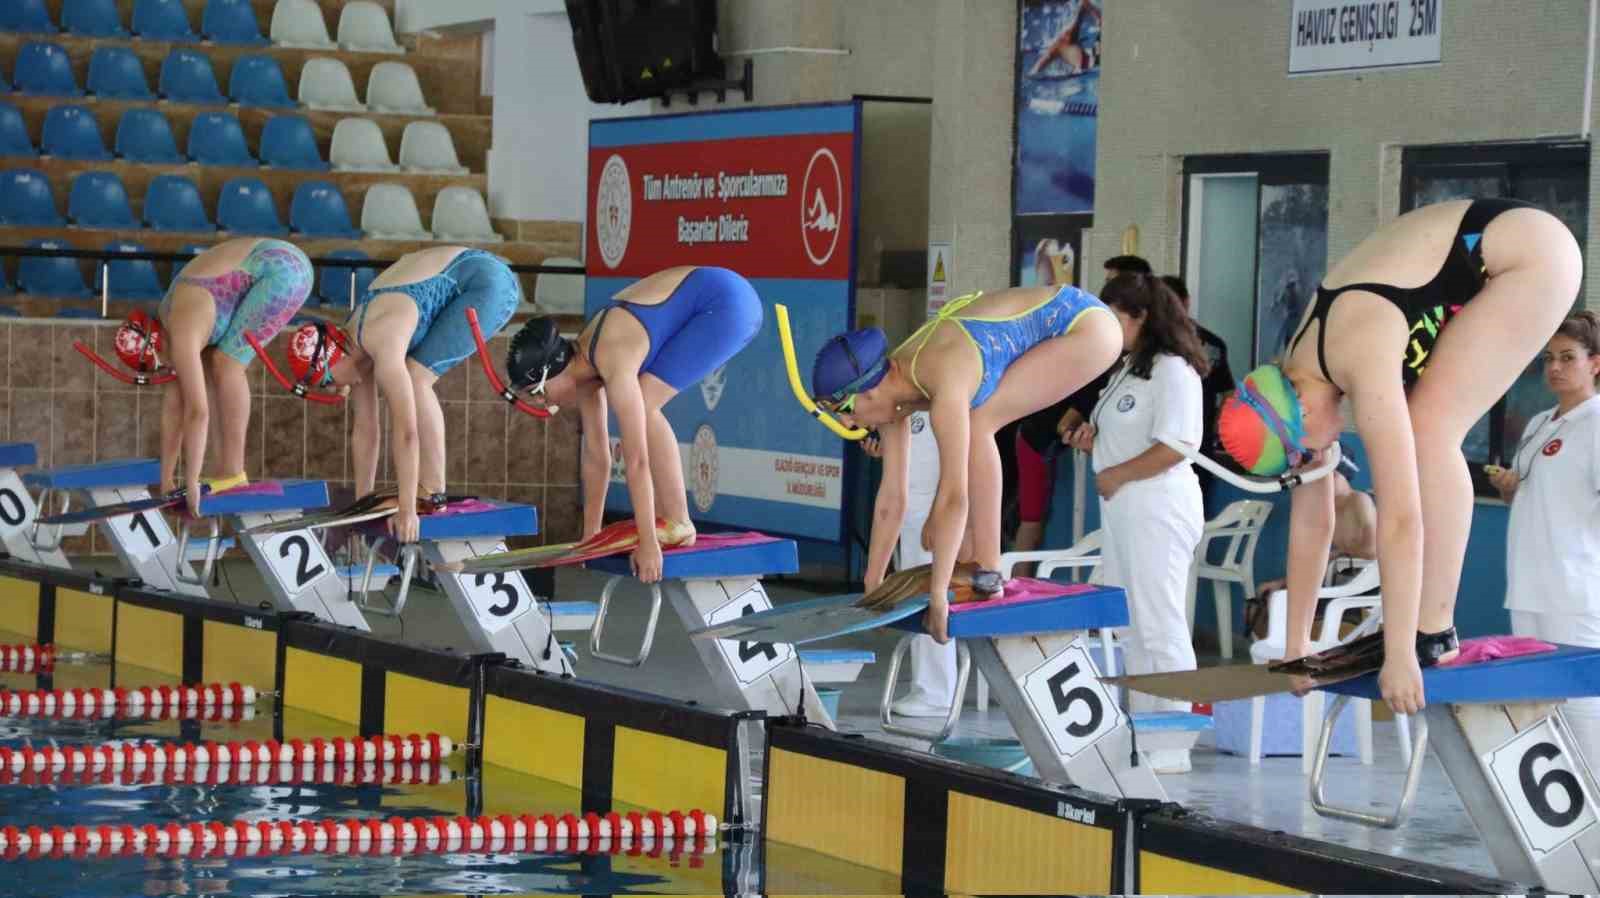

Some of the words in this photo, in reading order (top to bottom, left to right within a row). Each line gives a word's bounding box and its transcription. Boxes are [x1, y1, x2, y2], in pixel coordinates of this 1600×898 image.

[1297, 8, 1337, 46] HAVUZ
[1409, 0, 1437, 36] 25M
[643, 174, 662, 200] Tüm
[663, 172, 702, 200] Antrenör
[704, 177, 715, 198] ve
[718, 169, 788, 202] Sporcularımıza
[678, 216, 718, 246] Başarılar
[719, 214, 749, 242] Dileriz
[0, 488, 26, 526] 0
[129, 512, 161, 548] 1
[280, 535, 325, 588] 2
[475, 572, 519, 617] 3
[738, 603, 778, 664] 4
[1046, 661, 1104, 738] 5
[1518, 742, 1585, 828] 6
